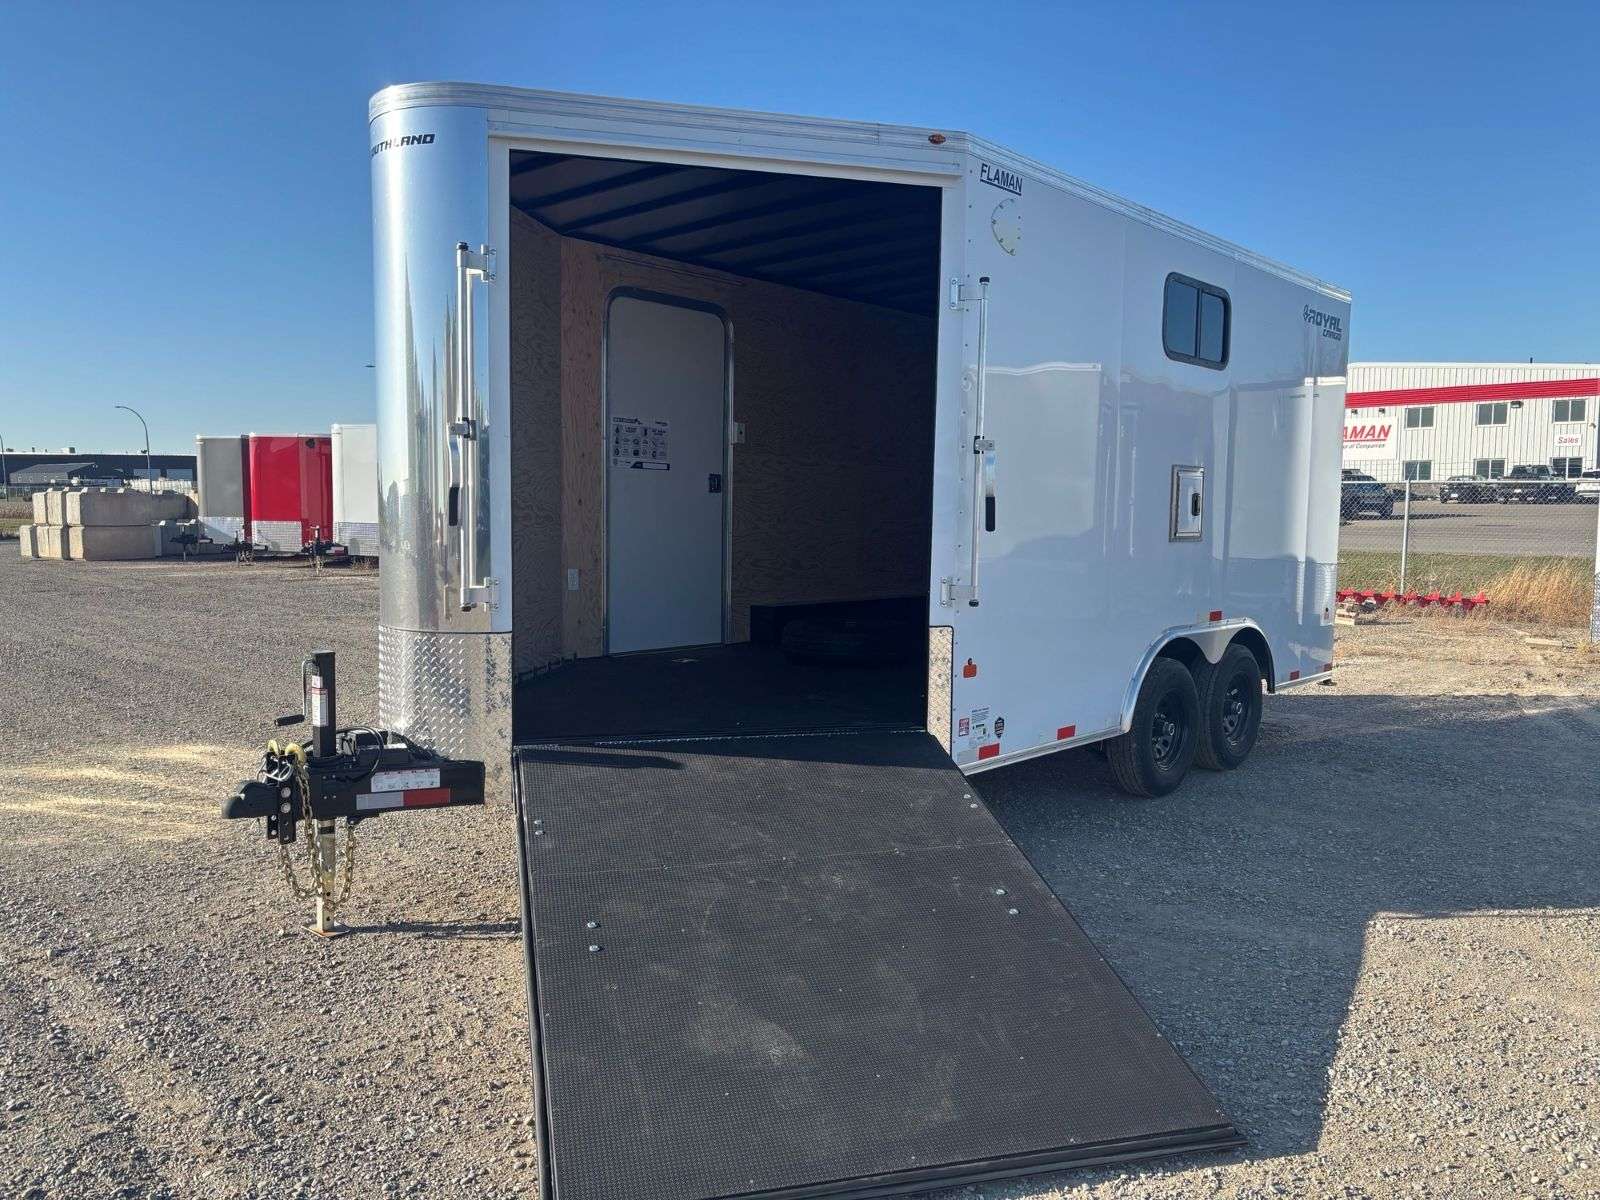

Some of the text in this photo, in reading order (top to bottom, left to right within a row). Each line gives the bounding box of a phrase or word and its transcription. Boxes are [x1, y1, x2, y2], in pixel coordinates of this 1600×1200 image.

[980, 163, 1023, 193] FLAMAN
[1308, 309, 1343, 332] ROYAL
[1558, 436, 1580, 444] Sales
